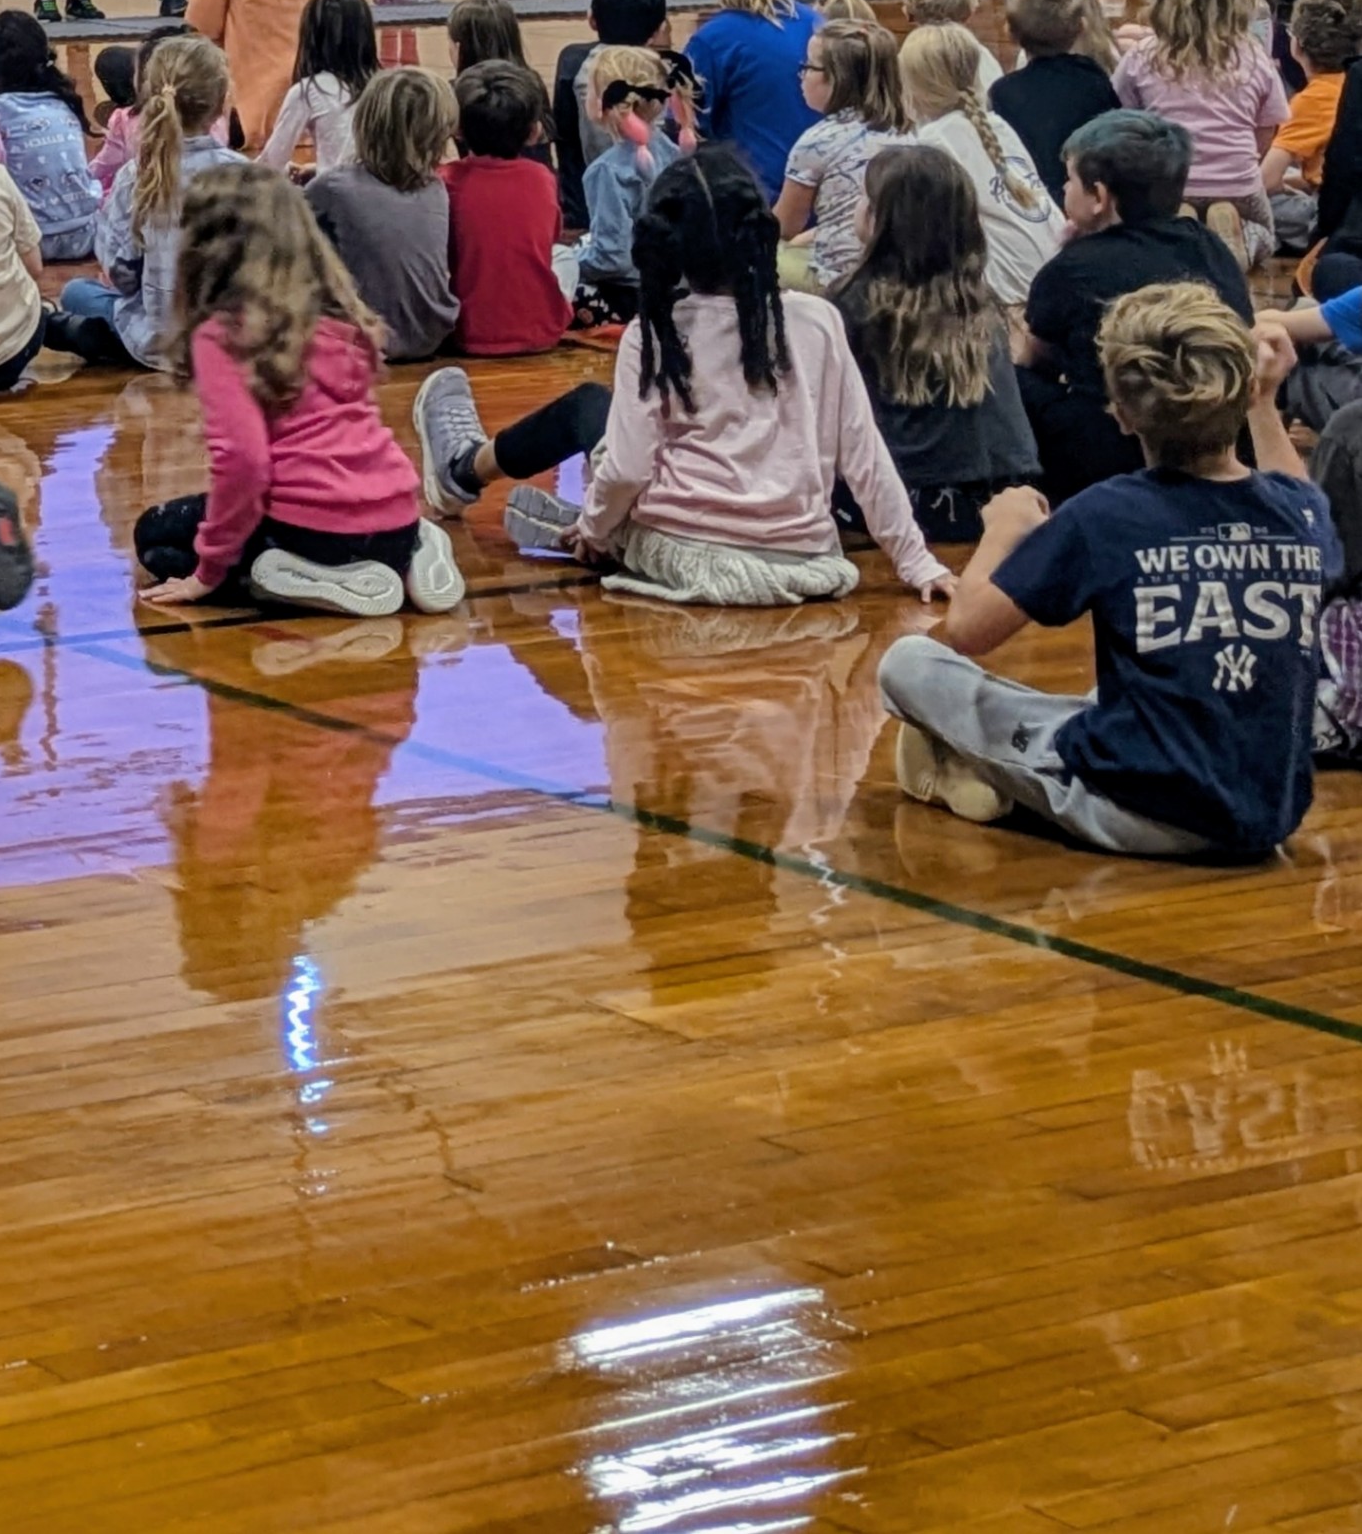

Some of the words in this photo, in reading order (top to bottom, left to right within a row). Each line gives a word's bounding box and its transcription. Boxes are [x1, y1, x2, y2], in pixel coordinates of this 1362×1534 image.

[1134, 546, 1190, 574] WE
[1194, 544, 1271, 570] OWN
[1276, 545, 1322, 571] THE
[1132, 580, 1322, 654] EAST
[1212, 643, 1257, 692] NY
